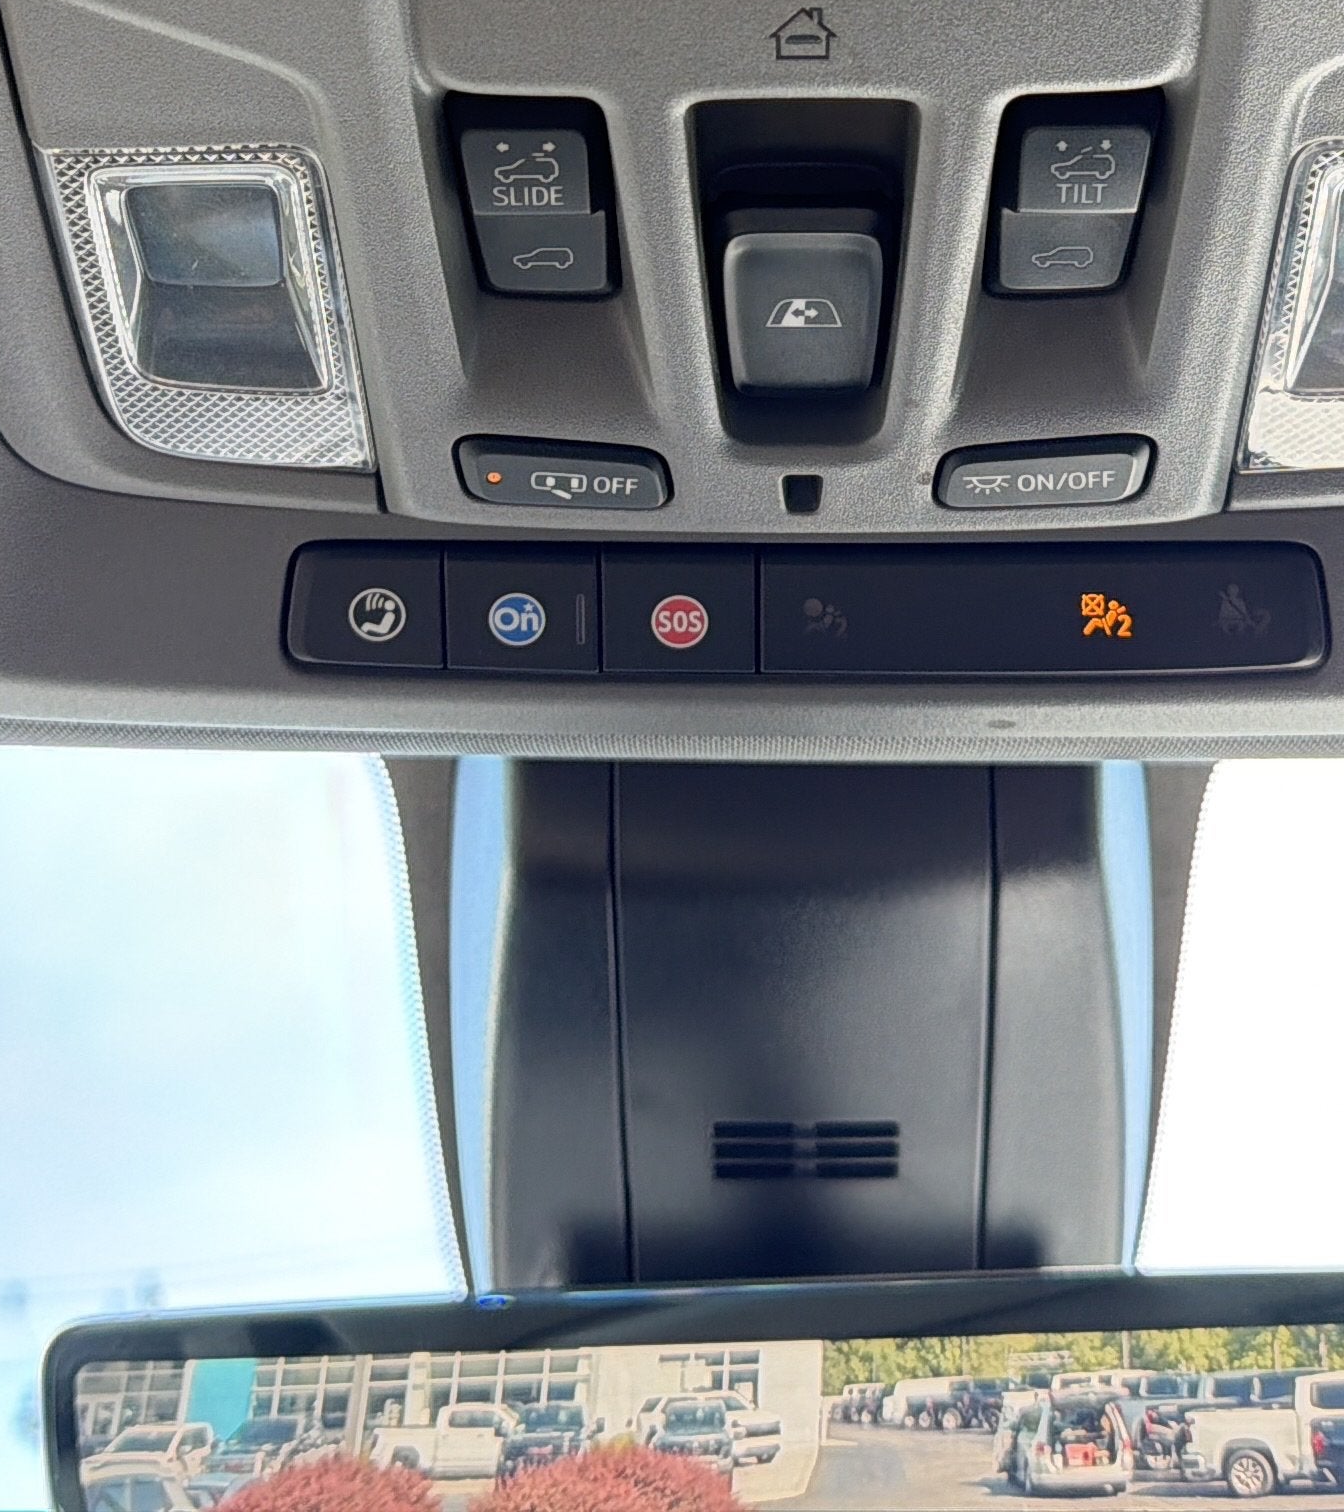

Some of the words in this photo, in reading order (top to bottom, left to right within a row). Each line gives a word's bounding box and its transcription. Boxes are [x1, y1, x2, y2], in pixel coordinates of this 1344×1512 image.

[492, 185, 565, 207] SLIDE
[1056, 183, 1108, 204] TILT
[593, 476, 639, 496] OFF
[1017, 470, 1116, 492] ON/OFF
[494, 607, 539, 632] On
[658, 610, 702, 634] SOS
